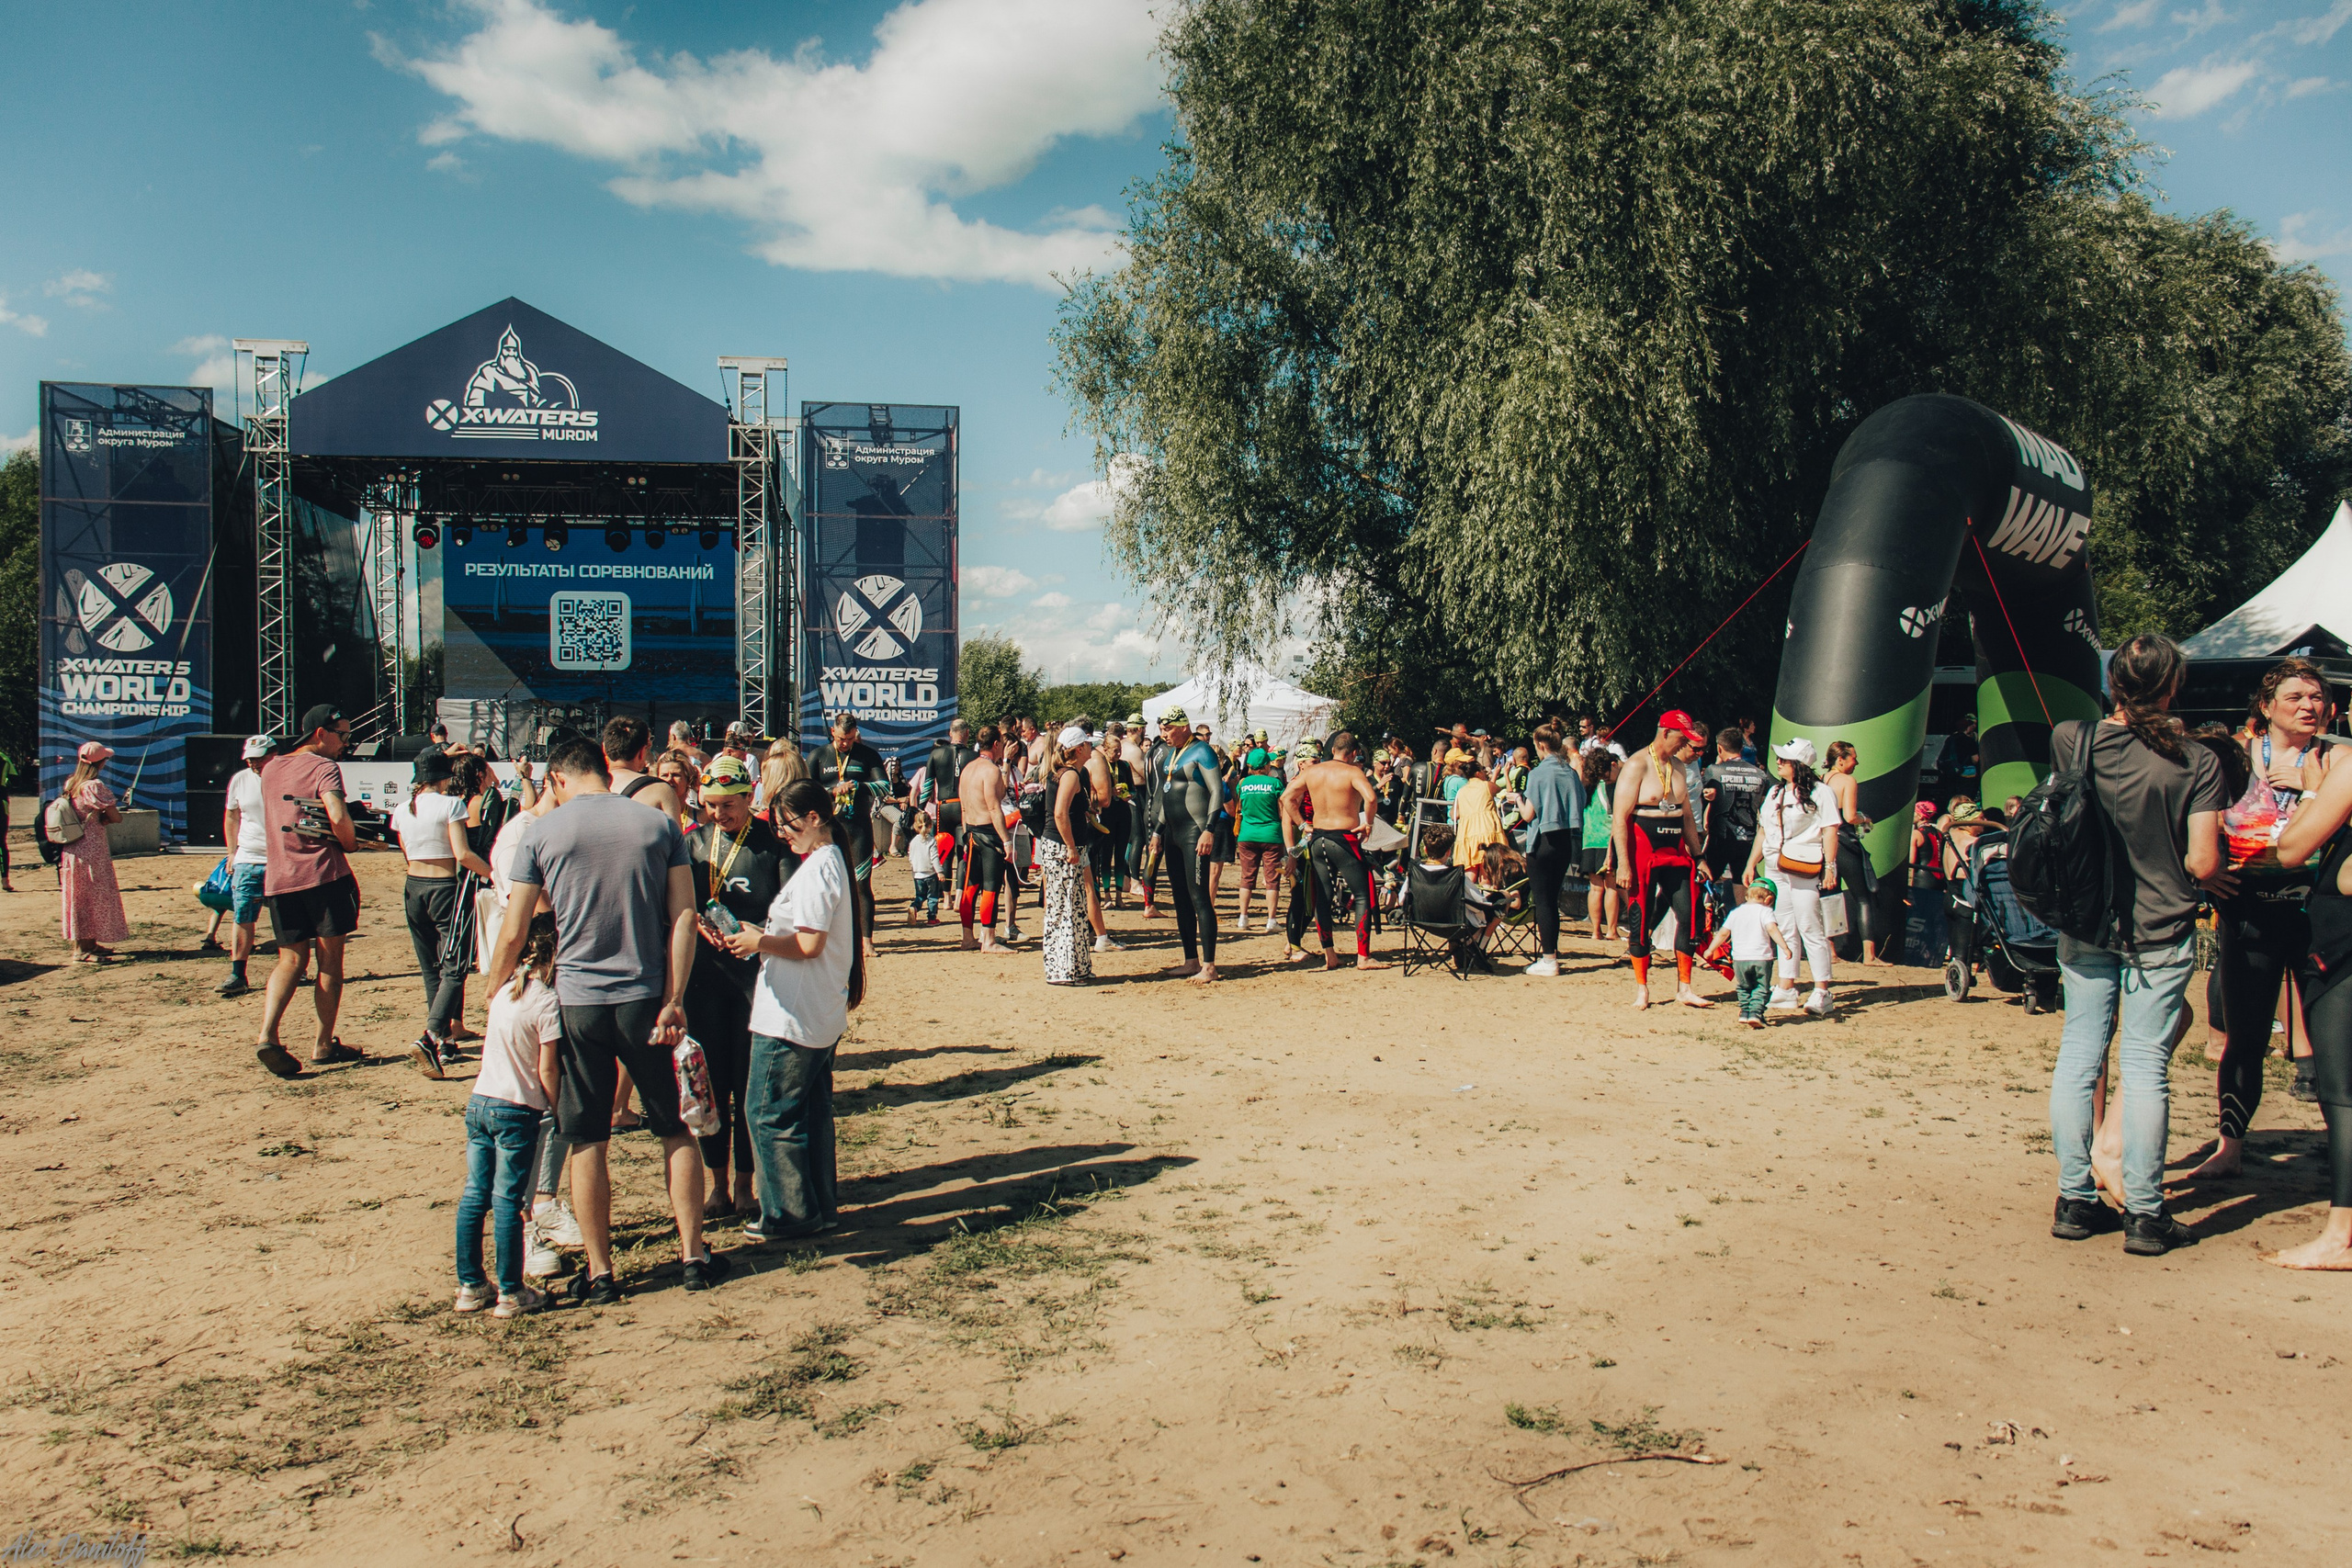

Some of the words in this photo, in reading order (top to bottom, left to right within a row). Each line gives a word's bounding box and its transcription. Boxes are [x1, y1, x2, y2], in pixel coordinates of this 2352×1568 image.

[97, 427, 186, 439] Администрация
[542, 428, 599, 442] MUROM
[97, 437, 135, 447] округа
[137, 438, 174, 448] Муром
[854, 446, 935, 457] Администрация
[1998, 414, 2085, 491] MAD
[854, 456, 888, 464] округа
[890, 456, 924, 466] Муром
[1987, 485, 2090, 570] WAVE
[465, 562, 575, 578] РЕЗУЛЬТАТЫ
[579, 563, 715, 580] СОРЕВНОВАНИЙ
[61, 674, 191, 703] WORLD
[820, 682, 939, 708] WORLD
[62, 702, 191, 716] CHAMPIONSHIP
[1240, 784, 1272, 793] ТРОИЦК
[724, 876, 752, 893] YR
